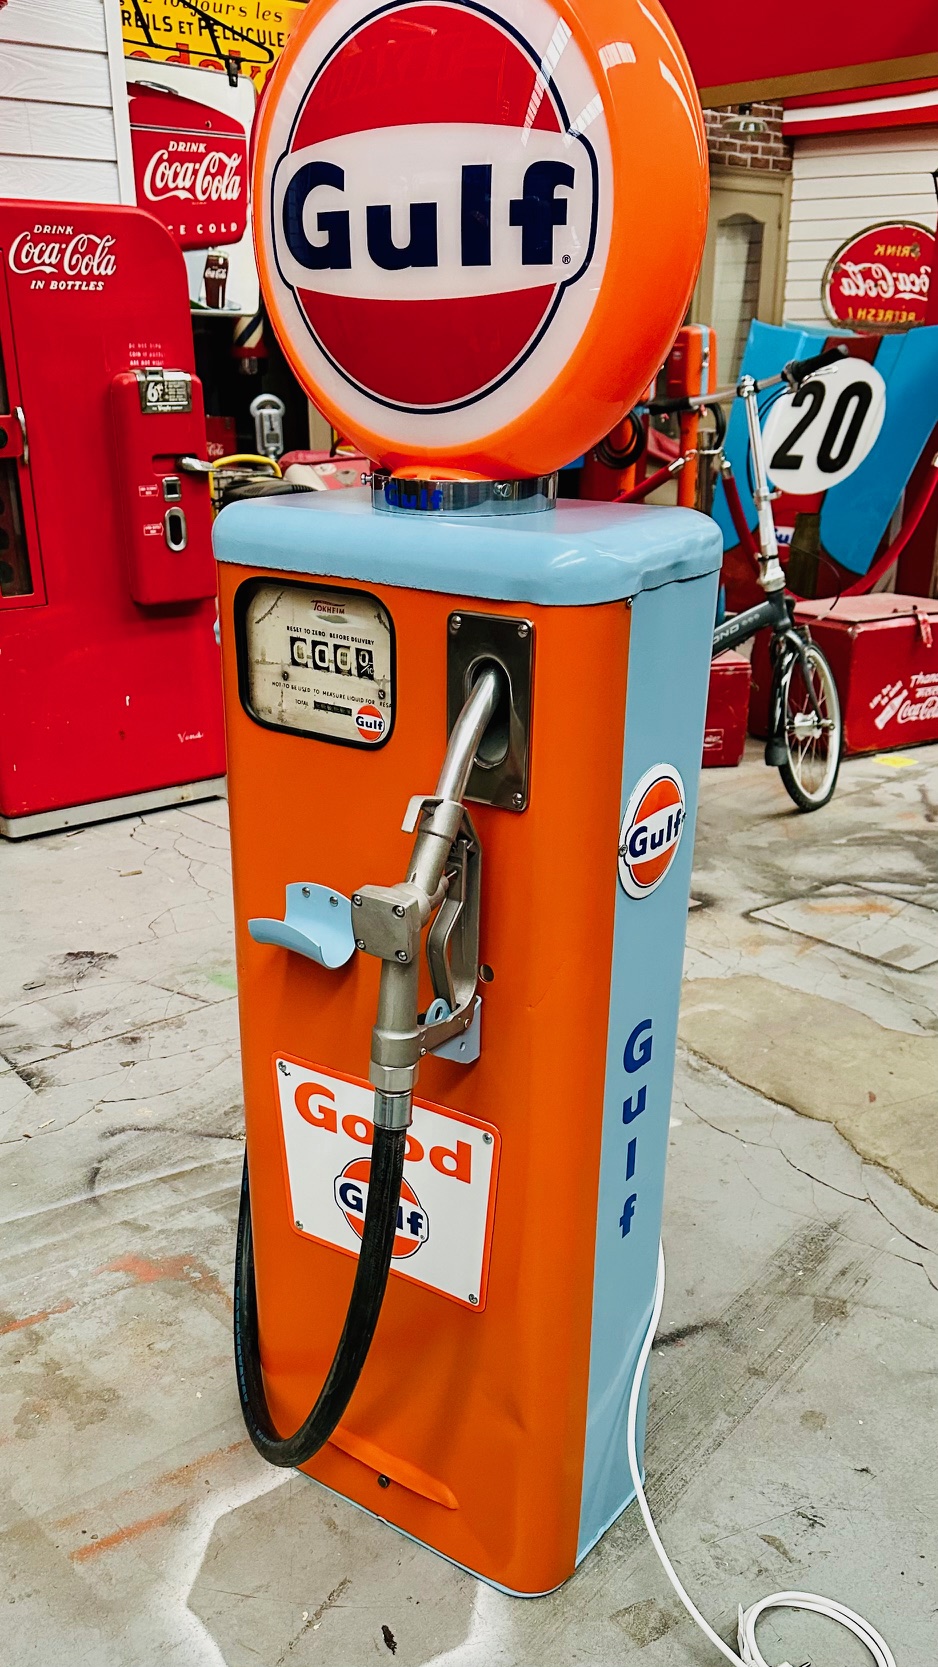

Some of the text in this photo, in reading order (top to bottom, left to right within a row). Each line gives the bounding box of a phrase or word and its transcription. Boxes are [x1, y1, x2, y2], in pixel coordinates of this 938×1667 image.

[255, 4, 284, 23] les
[178, 21, 194, 36] ET
[198, 17, 291, 48] PELLICULE
[168, 140, 208, 153] DRINK
[142, 150, 243, 202] Coca-Cola
[282, 160, 575, 271] Gulf
[33, 224, 74, 235] DRINK
[196, 221, 239, 235] COLD
[8, 230, 118, 276] Coca-Cola
[30, 280, 105, 291] IN BOTTLES
[769, 379, 873, 474] 20
[384, 483, 444, 511] Gulf
[311, 600, 346, 614] TOKHEIM
[286, 625, 302, 633] RESET
[311, 629, 326, 637] ZERO
[329, 632, 350, 642] BEFORE
[350, 636, 375, 646] DELIVERY
[322, 691, 346, 700] MEASURE
[346, 695, 365, 704] LIQUID
[365, 698, 376, 706] FOR
[355, 715, 384, 731] Gulf
[628, 808, 682, 858] Gulf
[619, 1018, 653, 1239] Gulf
[338, 1182, 424, 1237] Glf
